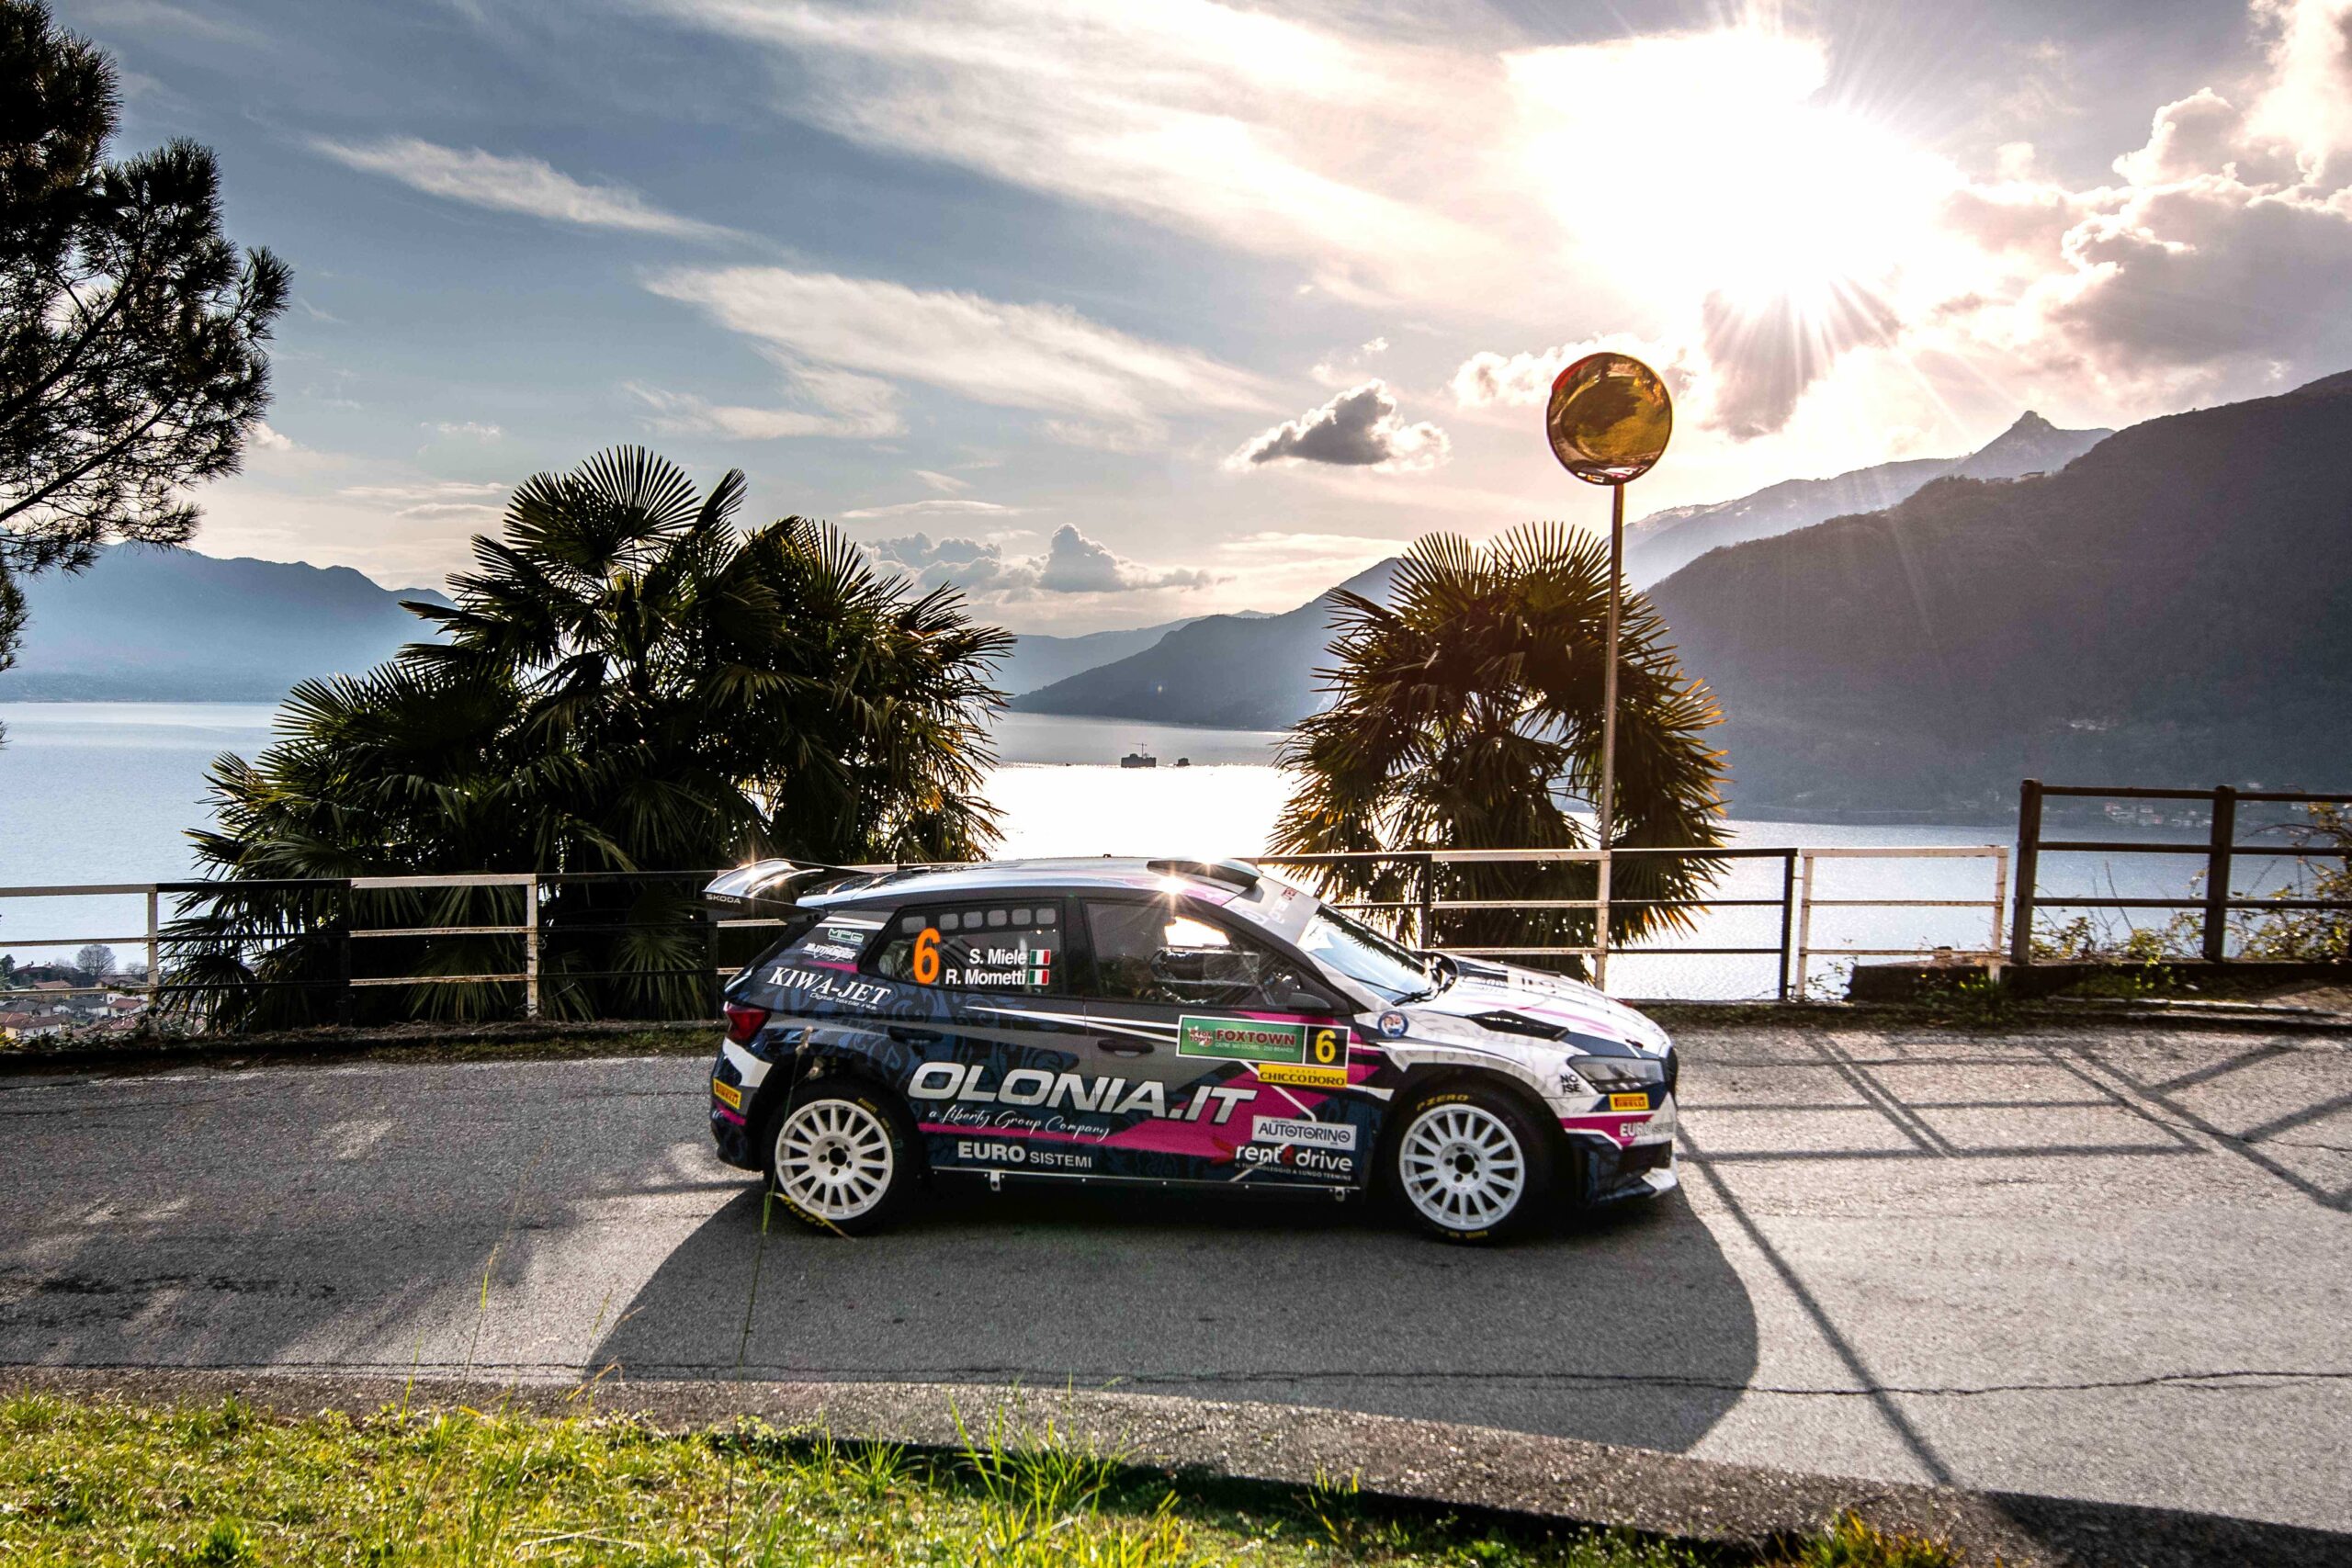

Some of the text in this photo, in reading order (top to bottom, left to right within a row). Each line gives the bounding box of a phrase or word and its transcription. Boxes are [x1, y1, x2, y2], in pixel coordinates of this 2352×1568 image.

[913, 928, 941, 985] 6
[969, 949, 1027, 964] S. Miele
[766, 966, 891, 1005] KIWA-JET
[945, 969, 1026, 986] R. Mometti
[1215, 1029, 1296, 1046] FOXTOWN
[1315, 1030, 1337, 1064] 6
[1260, 1071, 1307, 1083] CHICCO
[907, 1061, 1258, 1123] OLONIA.IT
[940, 1104, 990, 1129] Liberty
[994, 1110, 1042, 1135] Group
[1045, 1115, 1111, 1143] Company
[1258, 1122, 1351, 1143] AUTOTORINO
[957, 1141, 1092, 1168] EURO SISTEMI
